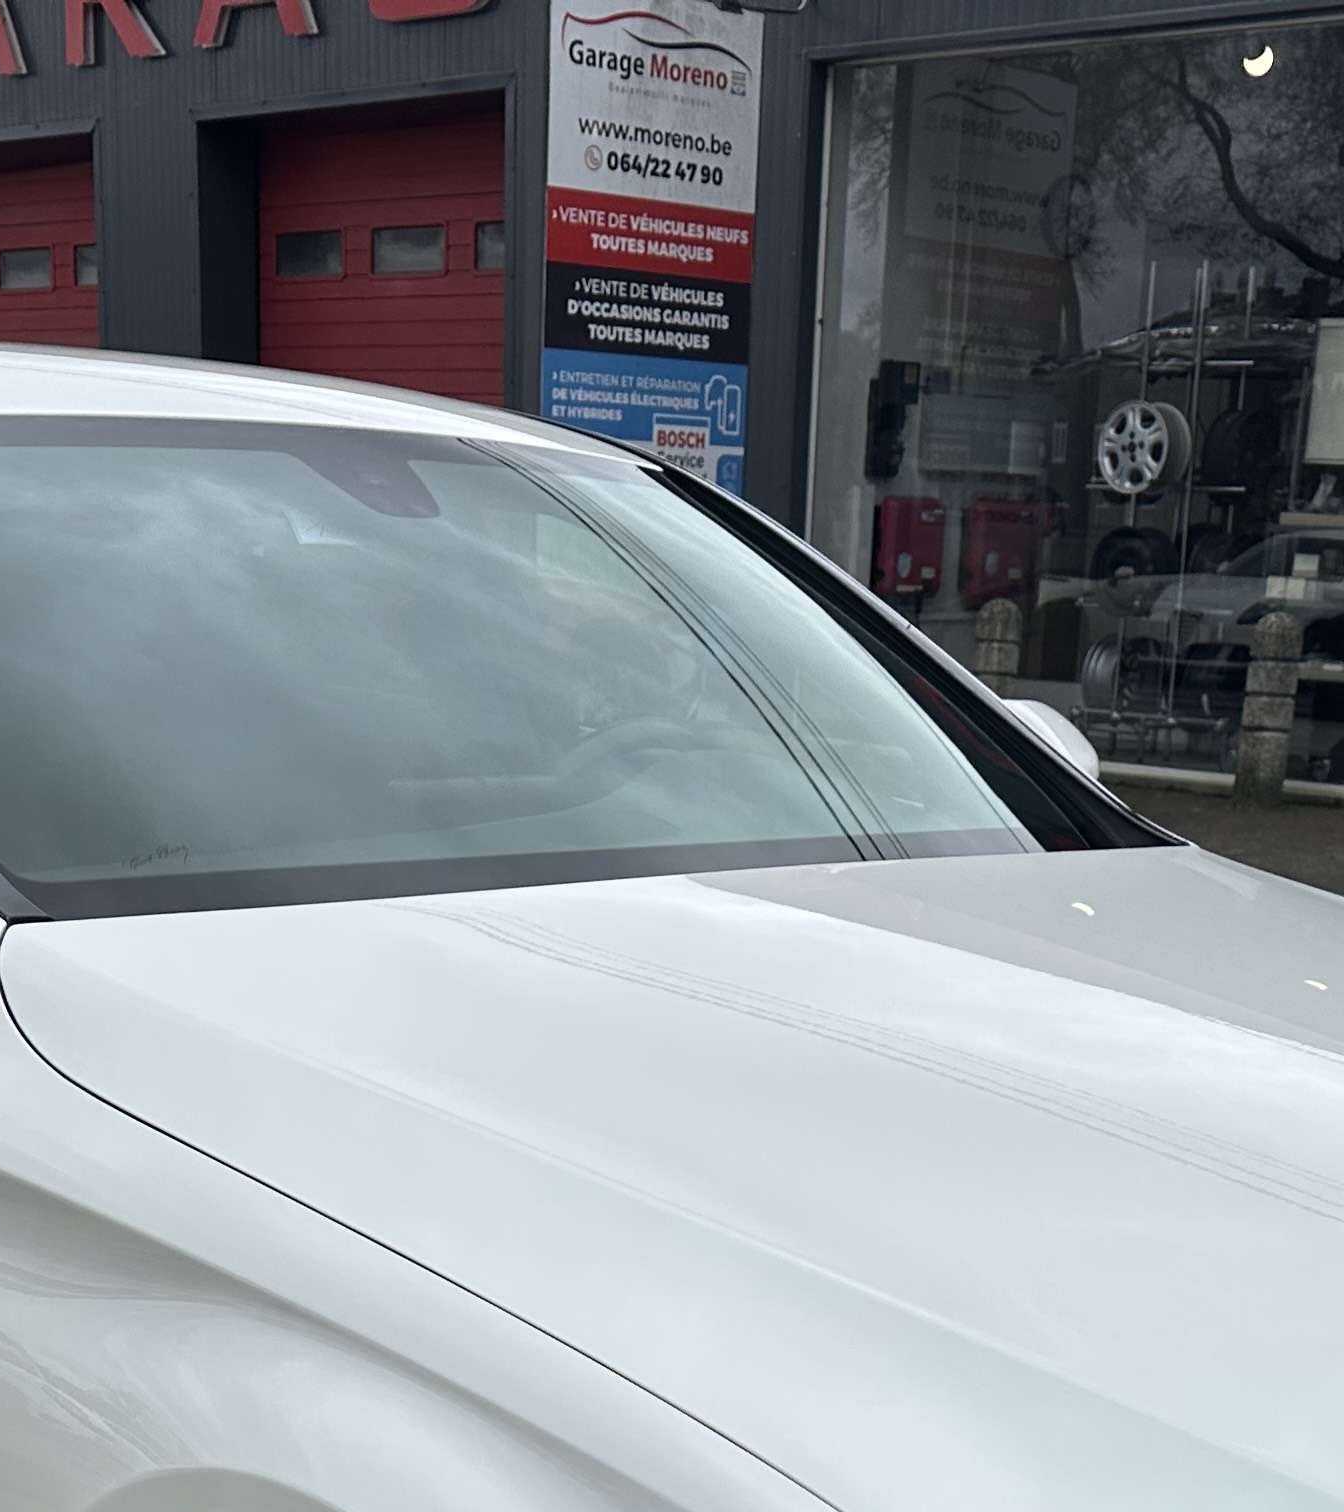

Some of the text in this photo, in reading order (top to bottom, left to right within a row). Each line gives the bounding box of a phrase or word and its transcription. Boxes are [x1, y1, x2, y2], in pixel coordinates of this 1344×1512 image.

[568, 39, 728, 90] Garage Moreno
[578, 117, 733, 157] www.moreno.be
[606, 150, 724, 186] 064/22 47 90
[559, 205, 749, 245] VENTE DE VÉHICULES NEUFS
[591, 233, 714, 263] TOUTES MARQUES
[581, 277, 724, 308] VENTE DE VÉHICULES
[567, 299, 730, 330] D'OCCASIONS GARANTIS
[588, 324, 710, 350] TOUTES MARQUES
[552, 388, 569, 401] DE
[570, 387, 629, 405] VÉHICULES
[559, 370, 702, 394] ENTRETIEN ET RÉPARATION
[552, 404, 566, 418] ET
[657, 429, 706, 449] BOSCH
